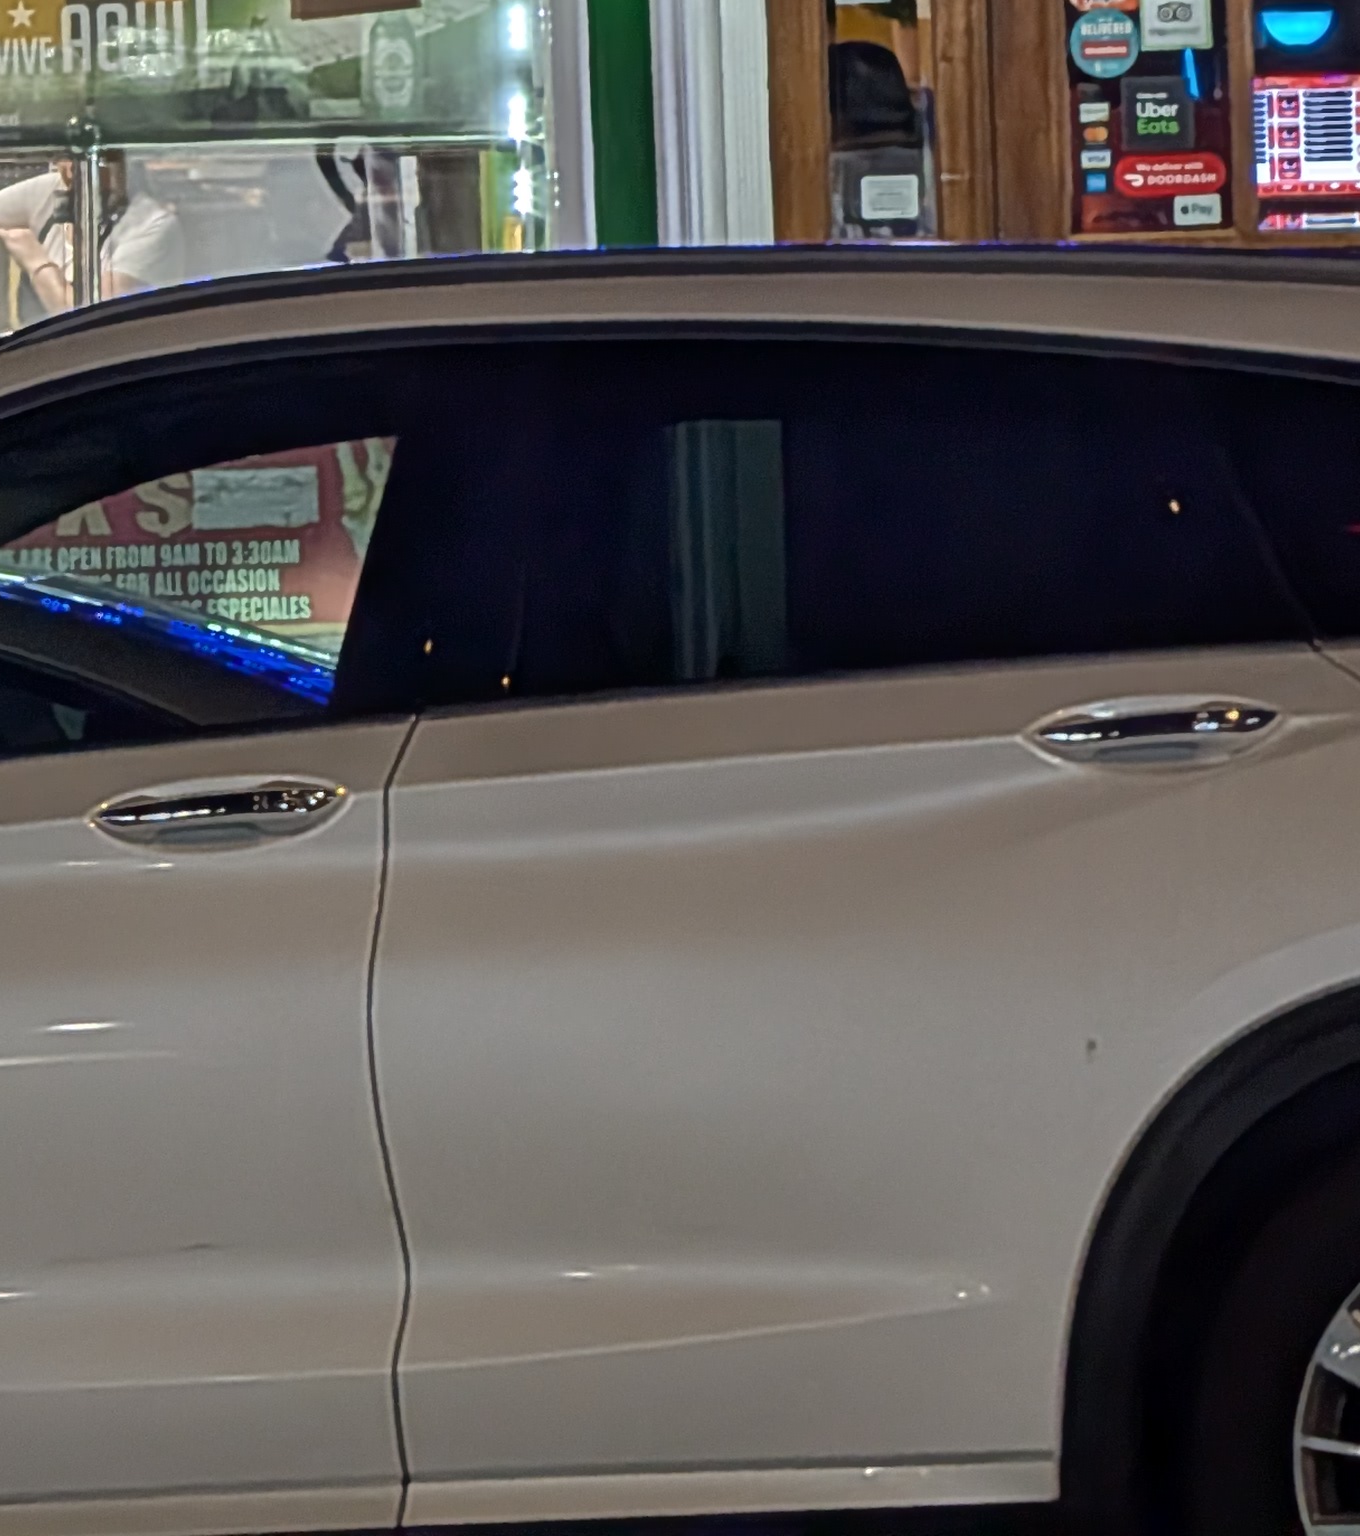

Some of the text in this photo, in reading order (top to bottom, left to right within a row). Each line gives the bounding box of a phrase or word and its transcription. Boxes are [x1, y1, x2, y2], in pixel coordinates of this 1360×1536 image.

[1136, 101, 1180, 118] Uber
[1136, 118, 1181, 136] Eats
[1146, 173, 1218, 185] DOORDASH
[57, 546, 102, 572] OPEN
[105, 544, 156, 570] FROM
[160, 542, 201, 567] 9AM
[204, 541, 228, 565] TO
[231, 539, 300, 564] 3:30AM
[154, 570, 184, 597] ALL
[187, 568, 281, 595] OCCASION
